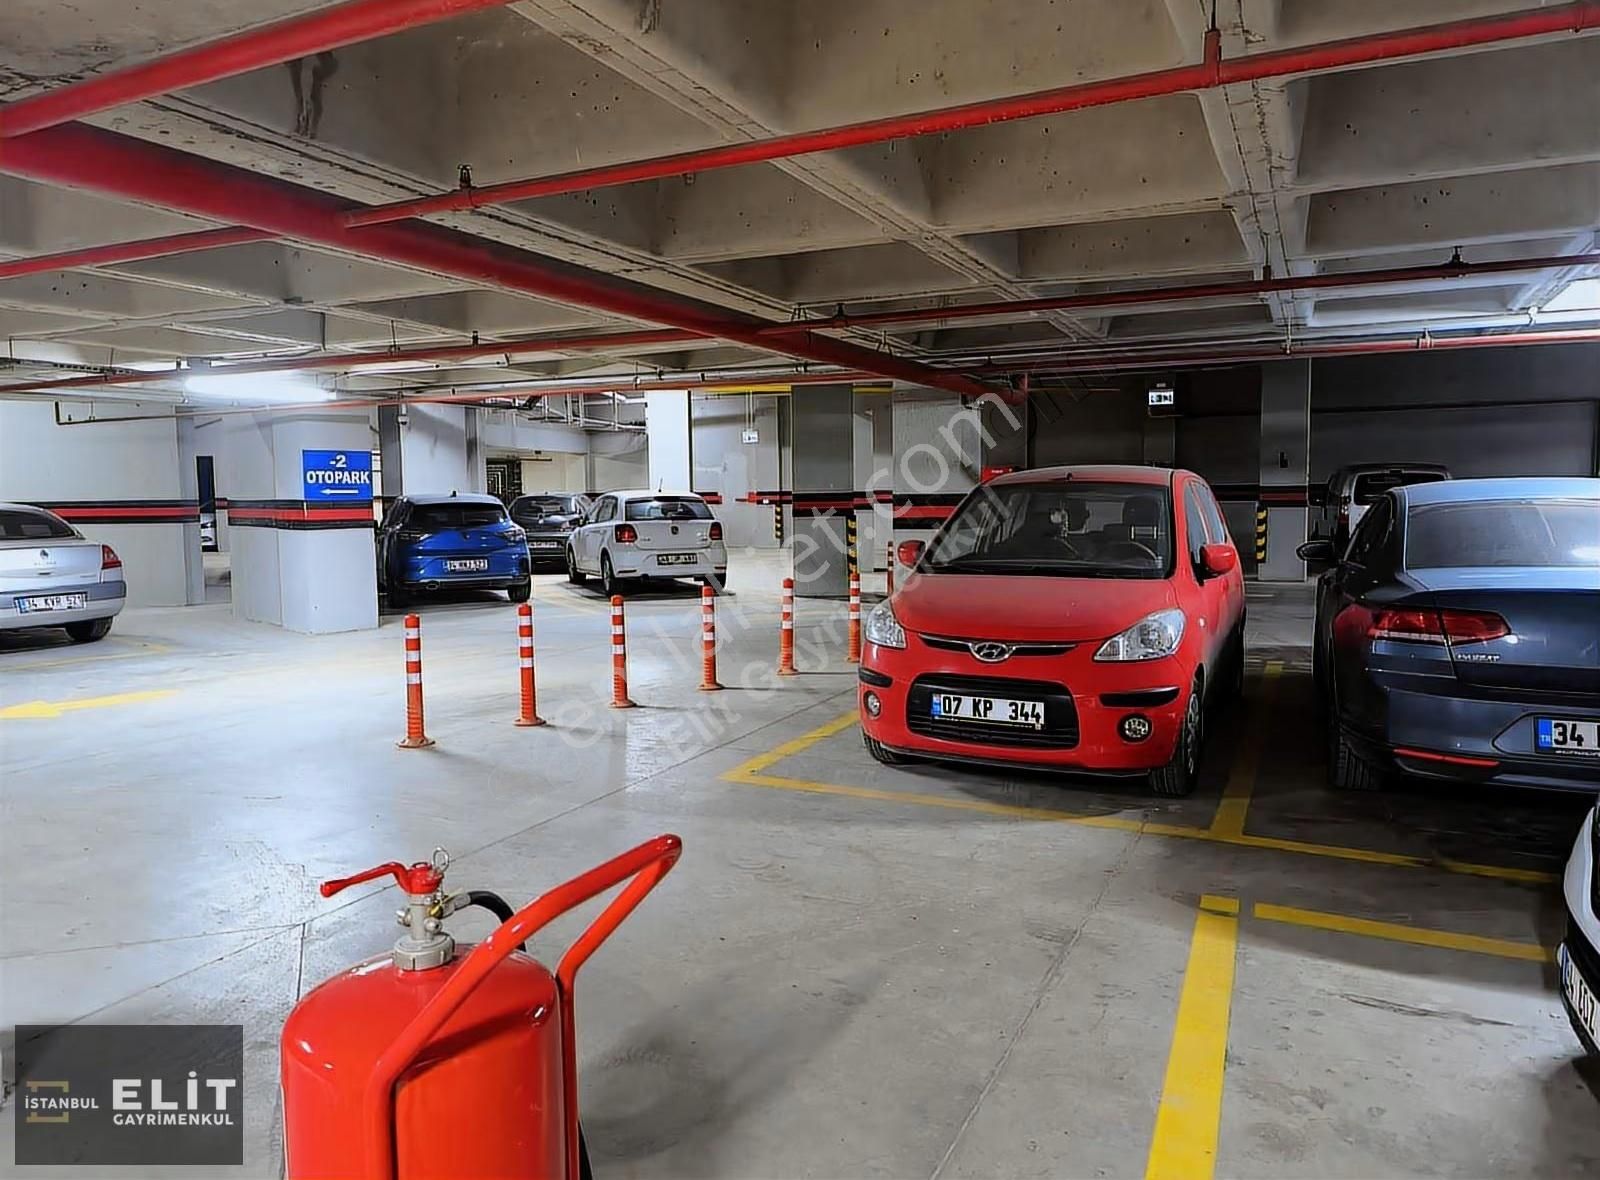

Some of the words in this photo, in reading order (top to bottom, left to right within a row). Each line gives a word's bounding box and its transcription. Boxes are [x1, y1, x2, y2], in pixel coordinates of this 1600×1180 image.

[329, 454, 347, 468] -2
[306, 470, 370, 484] OTOPARK
[942, 695, 962, 715] 07
[972, 698, 993, 718] KP
[1008, 701, 1041, 724] 344
[1553, 722, 1584, 747] 34
